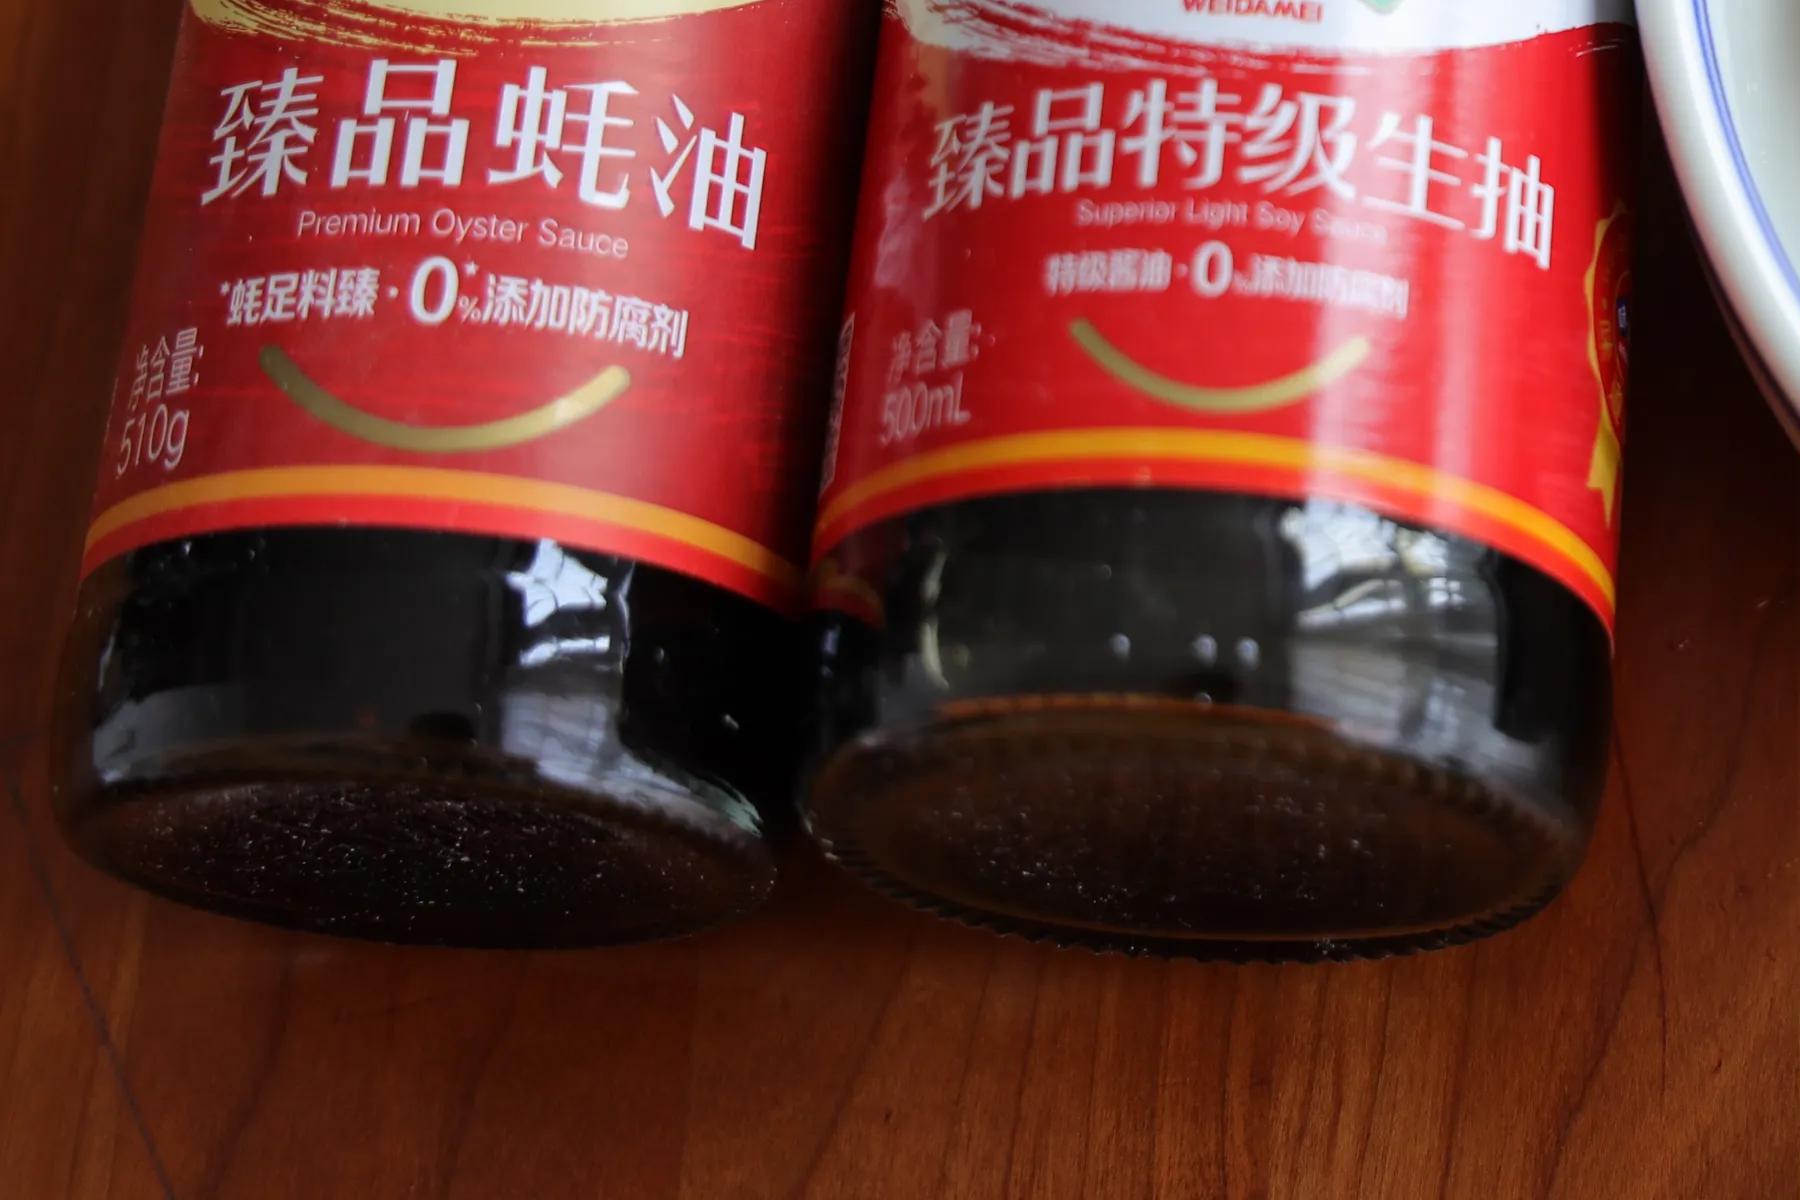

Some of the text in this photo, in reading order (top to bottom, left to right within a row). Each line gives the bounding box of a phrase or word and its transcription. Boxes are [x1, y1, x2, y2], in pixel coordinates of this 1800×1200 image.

[201, 57, 768, 252] 臻品蚝油
[923, 77, 1555, 271] 臻品特级生抽
[298, 207, 629, 259] Premium Oyster Sauce
[1074, 198, 1177, 229] Superior
[1187, 197, 1248, 230] Light
[1256, 200, 1306, 235] Soy
[115, 403, 191, 481] 510g
[879, 370, 972, 448] 500mL
